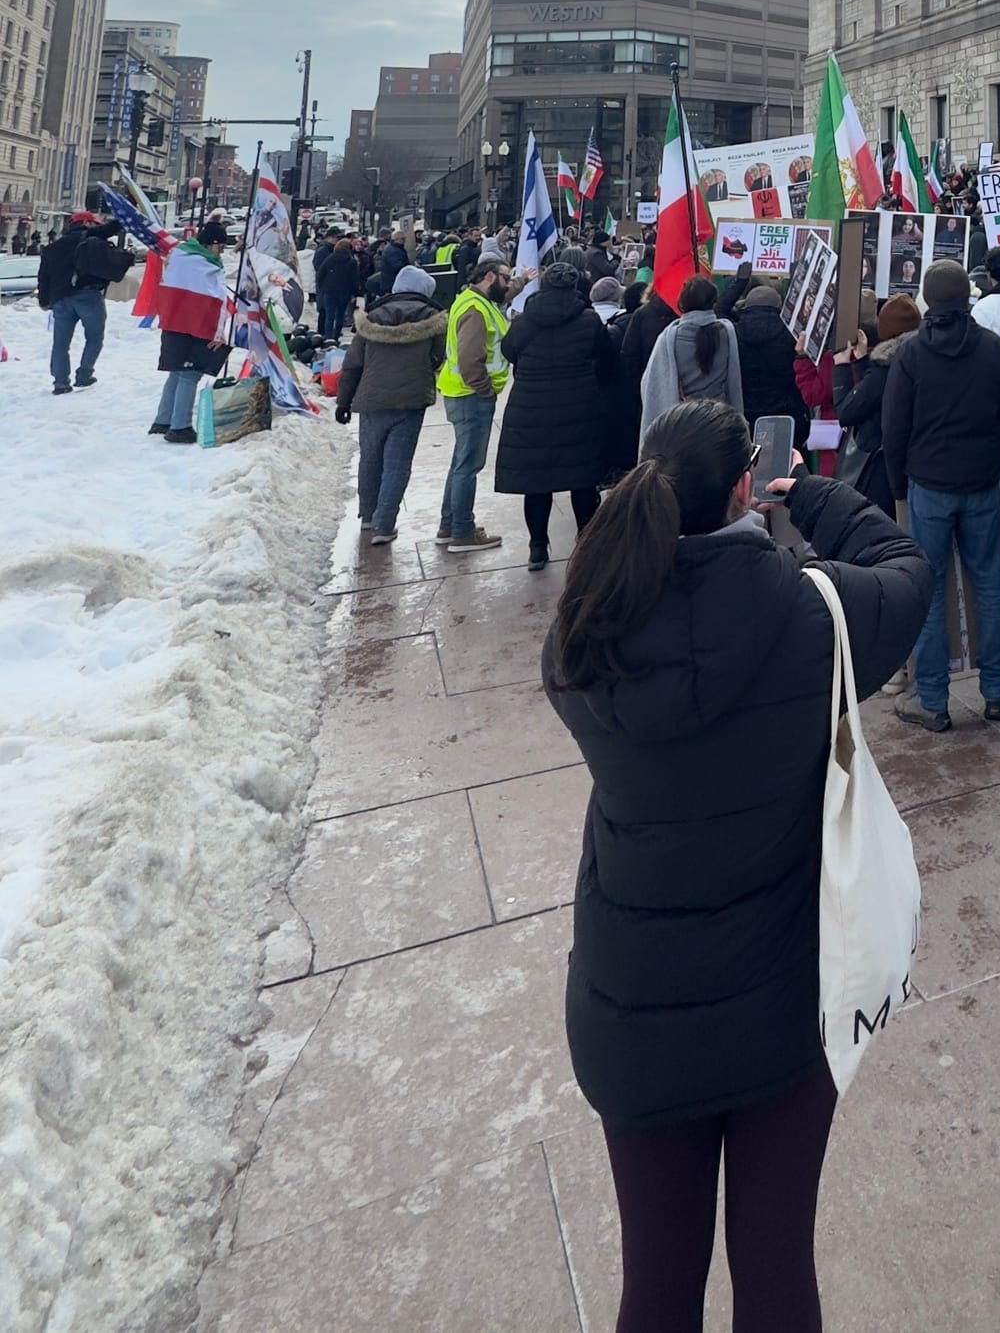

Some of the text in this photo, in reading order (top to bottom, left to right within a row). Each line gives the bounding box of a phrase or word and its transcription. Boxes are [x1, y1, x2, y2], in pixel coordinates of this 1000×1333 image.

[528, 3, 604, 23] WESTIN
[760, 225, 789, 235] FREE
[756, 260, 786, 270] IRAN
